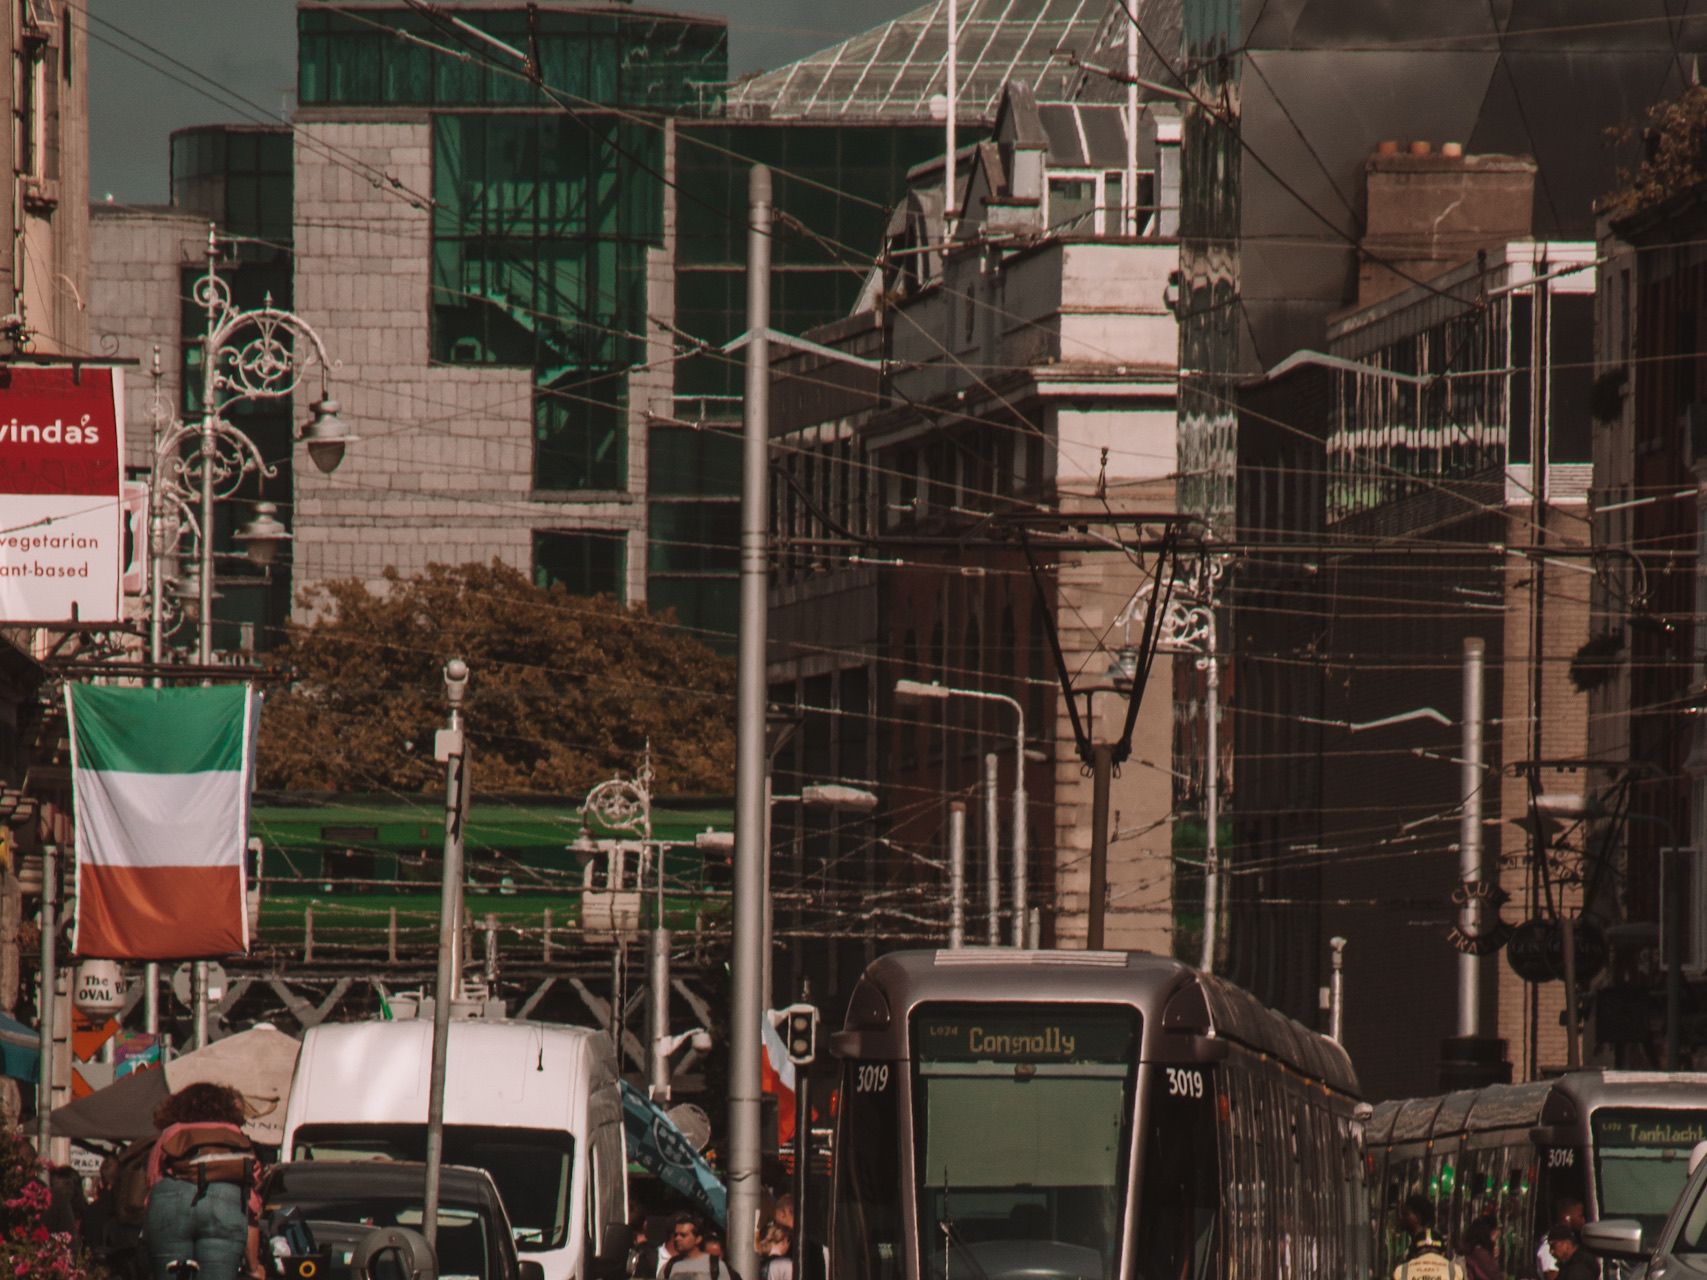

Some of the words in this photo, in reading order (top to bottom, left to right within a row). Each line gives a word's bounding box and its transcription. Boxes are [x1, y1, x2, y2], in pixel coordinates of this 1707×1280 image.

[85, 975, 109, 987] The
[79, 989, 112, 1001] OVAL
[856, 1064, 889, 1093] 3019
[1166, 1067, 1204, 1099] 3019
[1547, 1148, 1574, 1168] 3014
